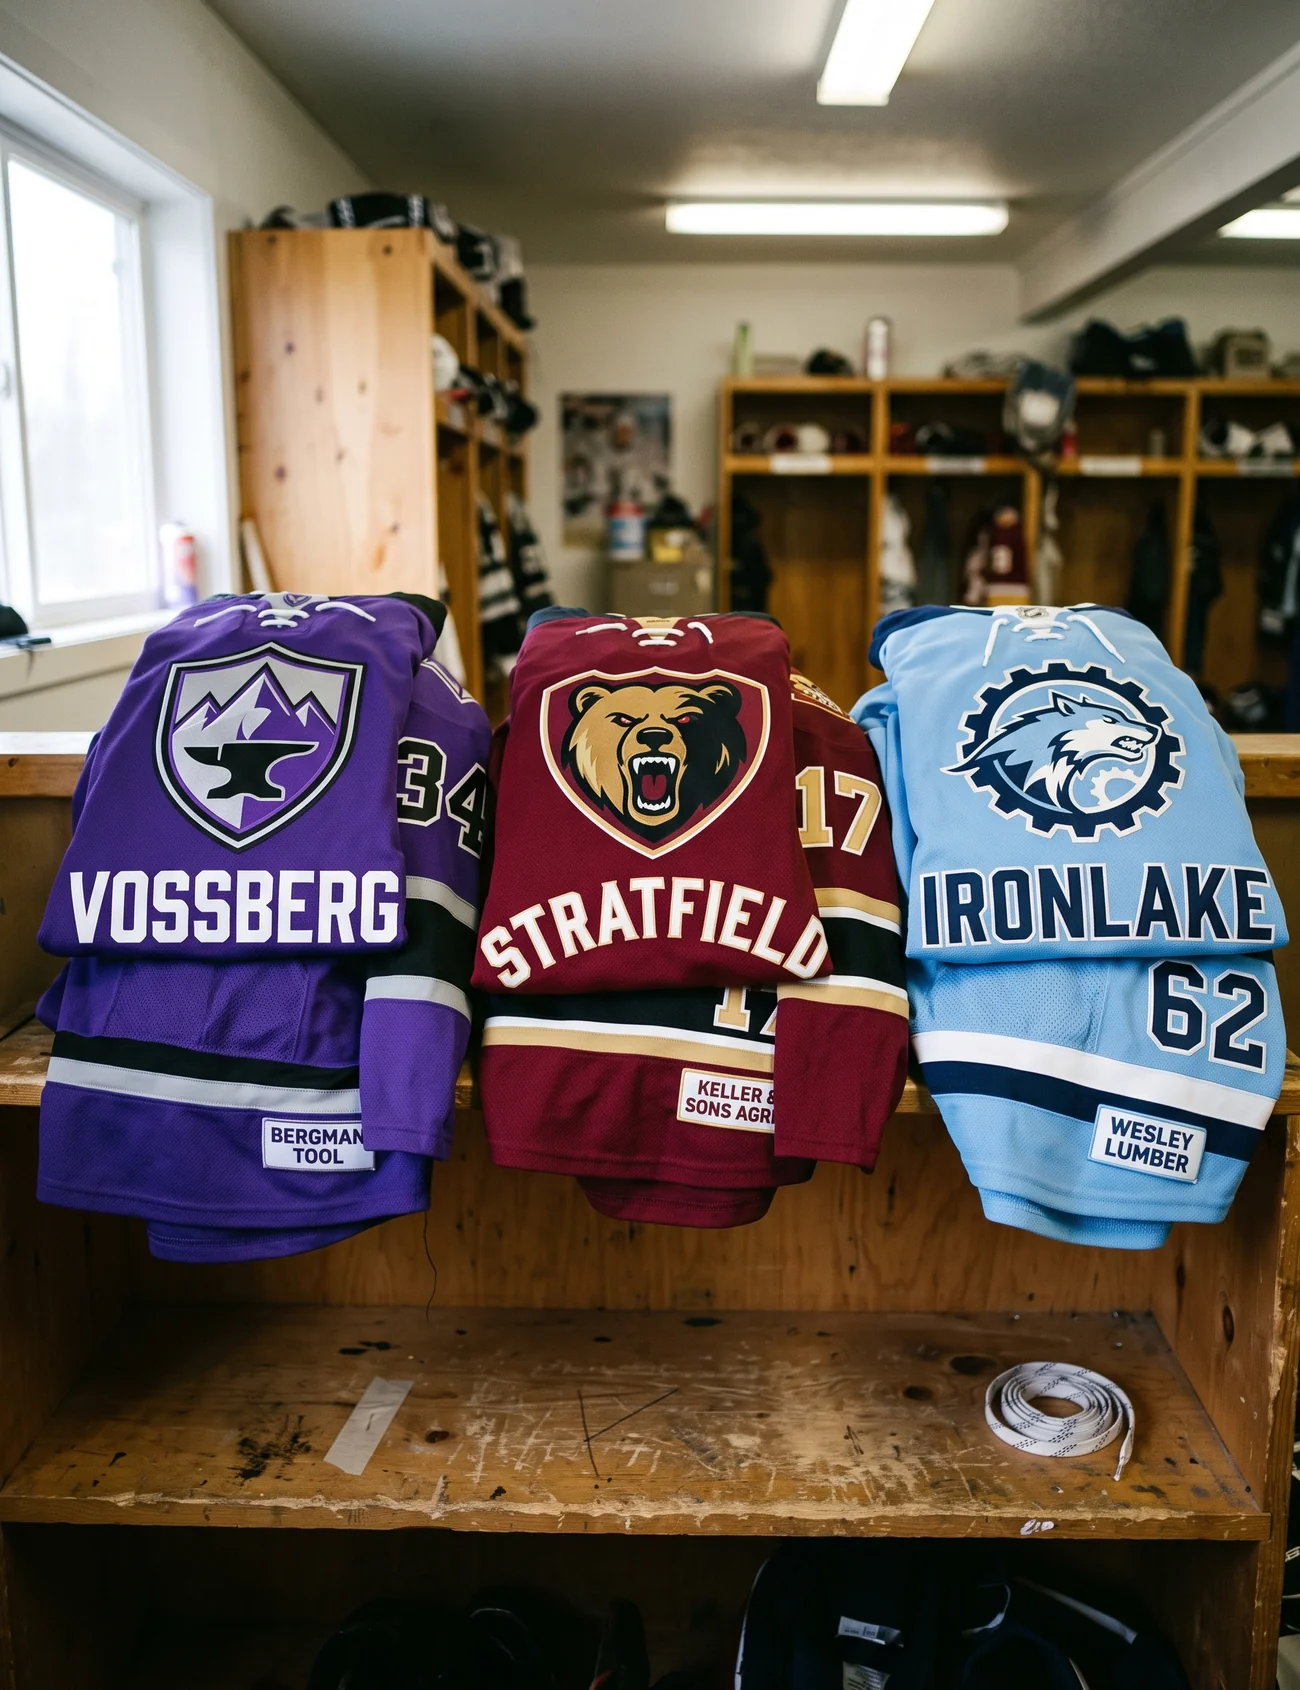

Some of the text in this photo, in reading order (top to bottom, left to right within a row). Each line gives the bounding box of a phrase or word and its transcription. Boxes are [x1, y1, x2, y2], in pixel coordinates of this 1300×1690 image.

[396, 736, 486, 859] 34
[795, 766, 882, 856] 17
[69, 869, 399, 944] VOSSBERG
[480, 876, 829, 988] STRATFIELD
[919, 862, 1275, 949] IRONLAKE
[1146, 959, 1268, 1075] 62
[685, 1097, 732, 1119] SONS
[697, 1079, 763, 1104] KELLER
[271, 1127, 364, 1145] BERGMAN
[293, 1148, 344, 1164] TOOL
[1104, 1138, 1189, 1173] LUMBER
[1111, 1116, 1194, 1151] WESLEY
